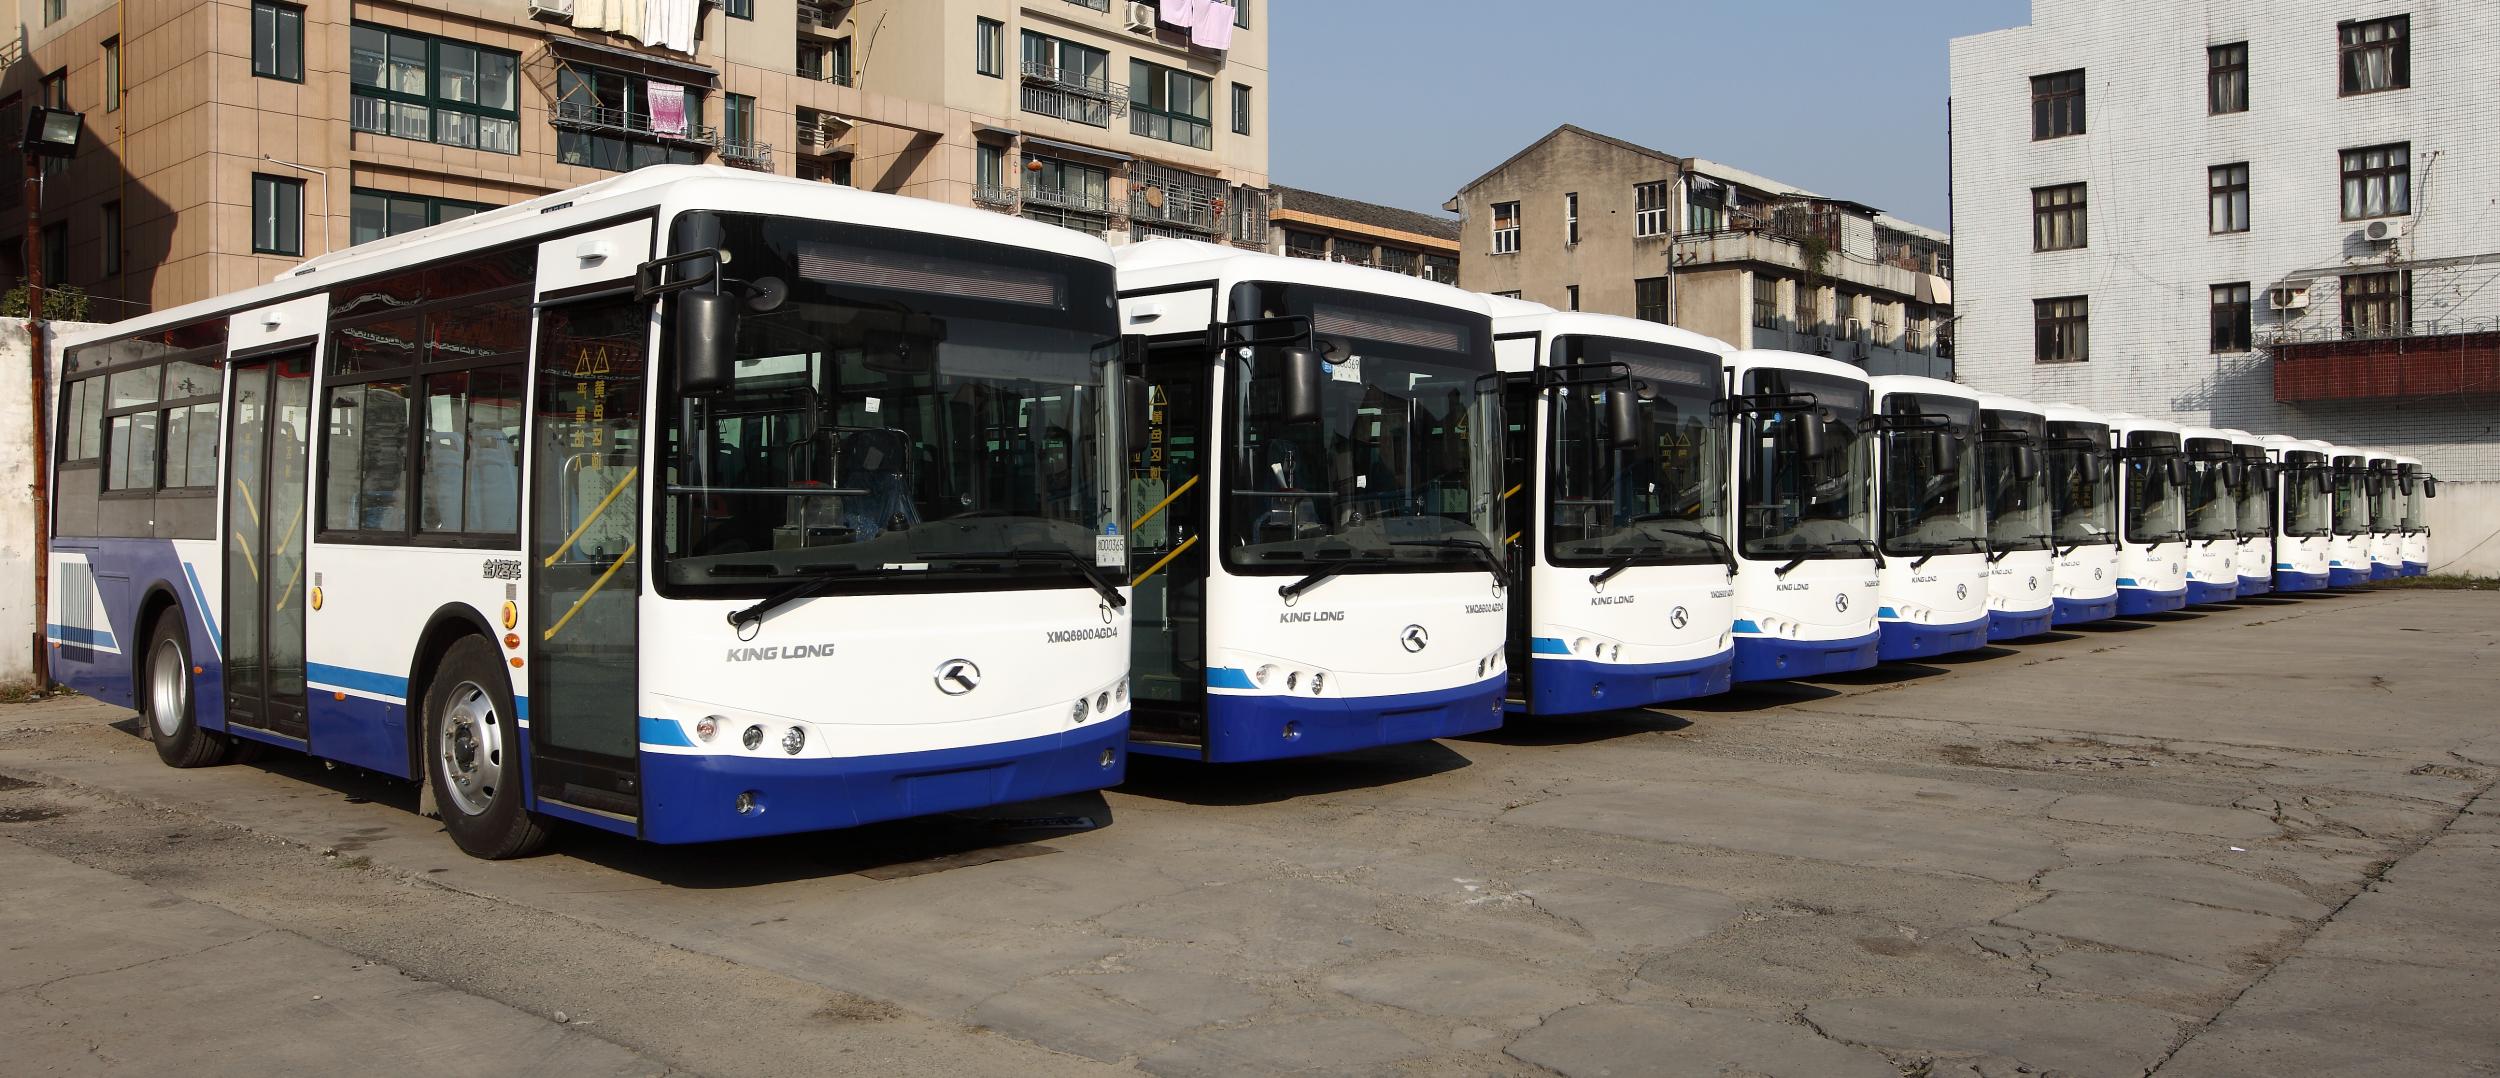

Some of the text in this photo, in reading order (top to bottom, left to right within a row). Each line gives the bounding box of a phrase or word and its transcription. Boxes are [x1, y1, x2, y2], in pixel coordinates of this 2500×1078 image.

[482, 558, 522, 581] 金龙客车
[1591, 595, 1635, 606] KING LONG
[1280, 610, 1345, 623] KING LONG
[1046, 626, 1119, 644] XMQ6900AGD4
[726, 643, 835, 662] KING LONG
